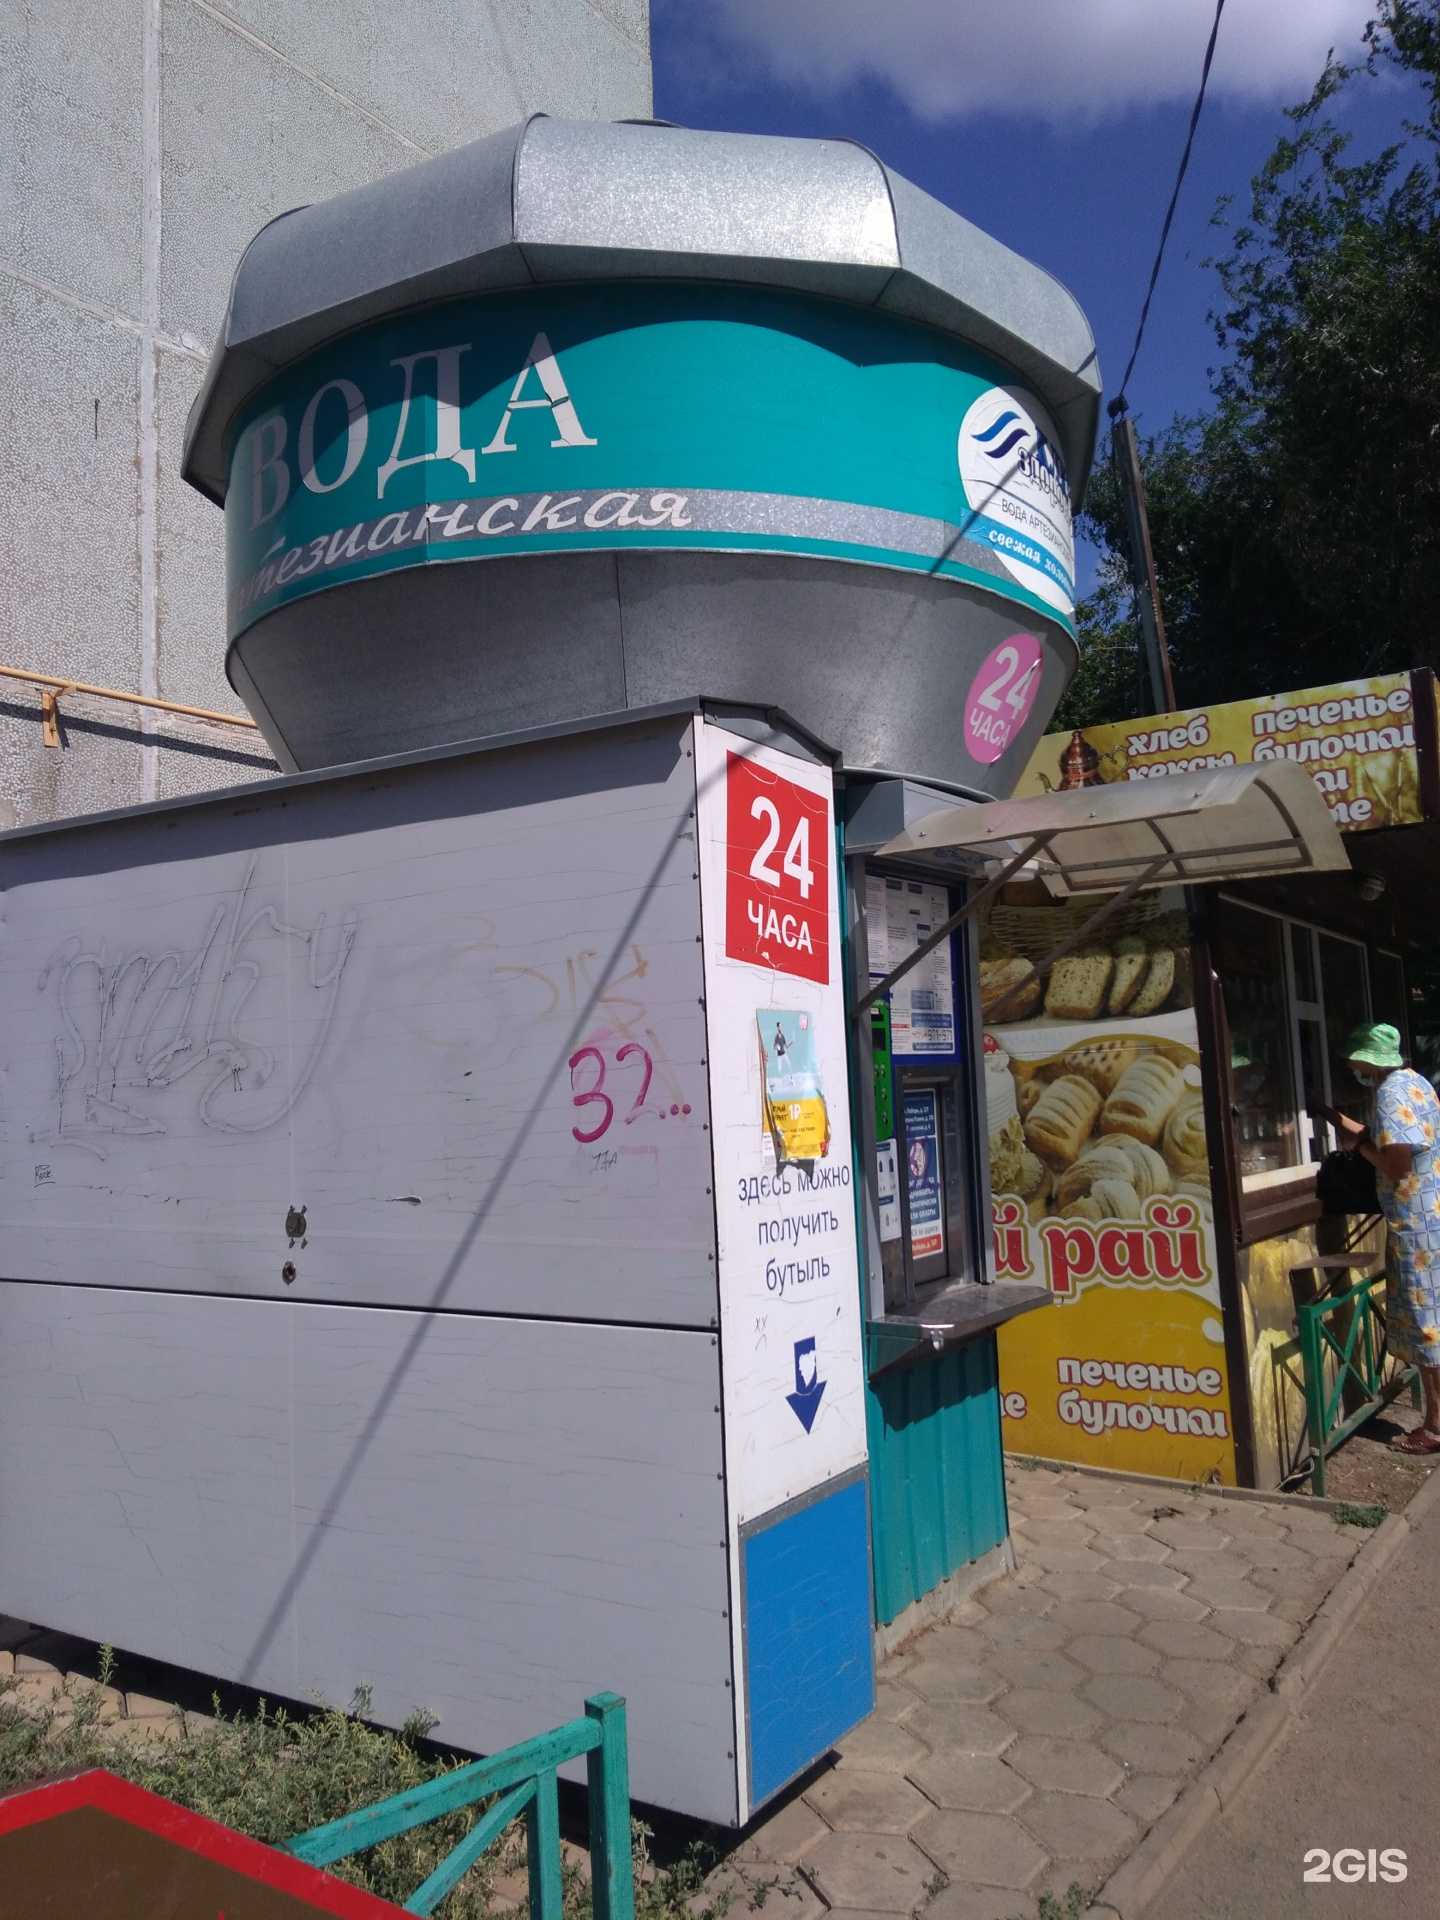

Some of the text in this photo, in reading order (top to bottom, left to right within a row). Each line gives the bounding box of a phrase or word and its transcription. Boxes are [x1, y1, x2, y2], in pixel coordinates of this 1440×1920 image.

[245, 331, 598, 531] ВОДА
[1001, 498, 1028, 524] ВОДА
[238, 491, 693, 603] тезианская
[989, 529, 1041, 565] свежая
[977, 645, 1041, 720] 24
[1127, 715, 1209, 757] хлеб
[1254, 690, 1411, 736] печенье
[749, 795, 815, 900] 24
[747, 898, 814, 956] ЧАСА
[757, 1210, 839, 1248] получить
[1043, 1205, 1205, 1292] рай
[765, 1255, 831, 1297] бутыль
[1057, 1358, 1223, 1396] печенье
[1058, 1389, 1229, 1439] булочки
